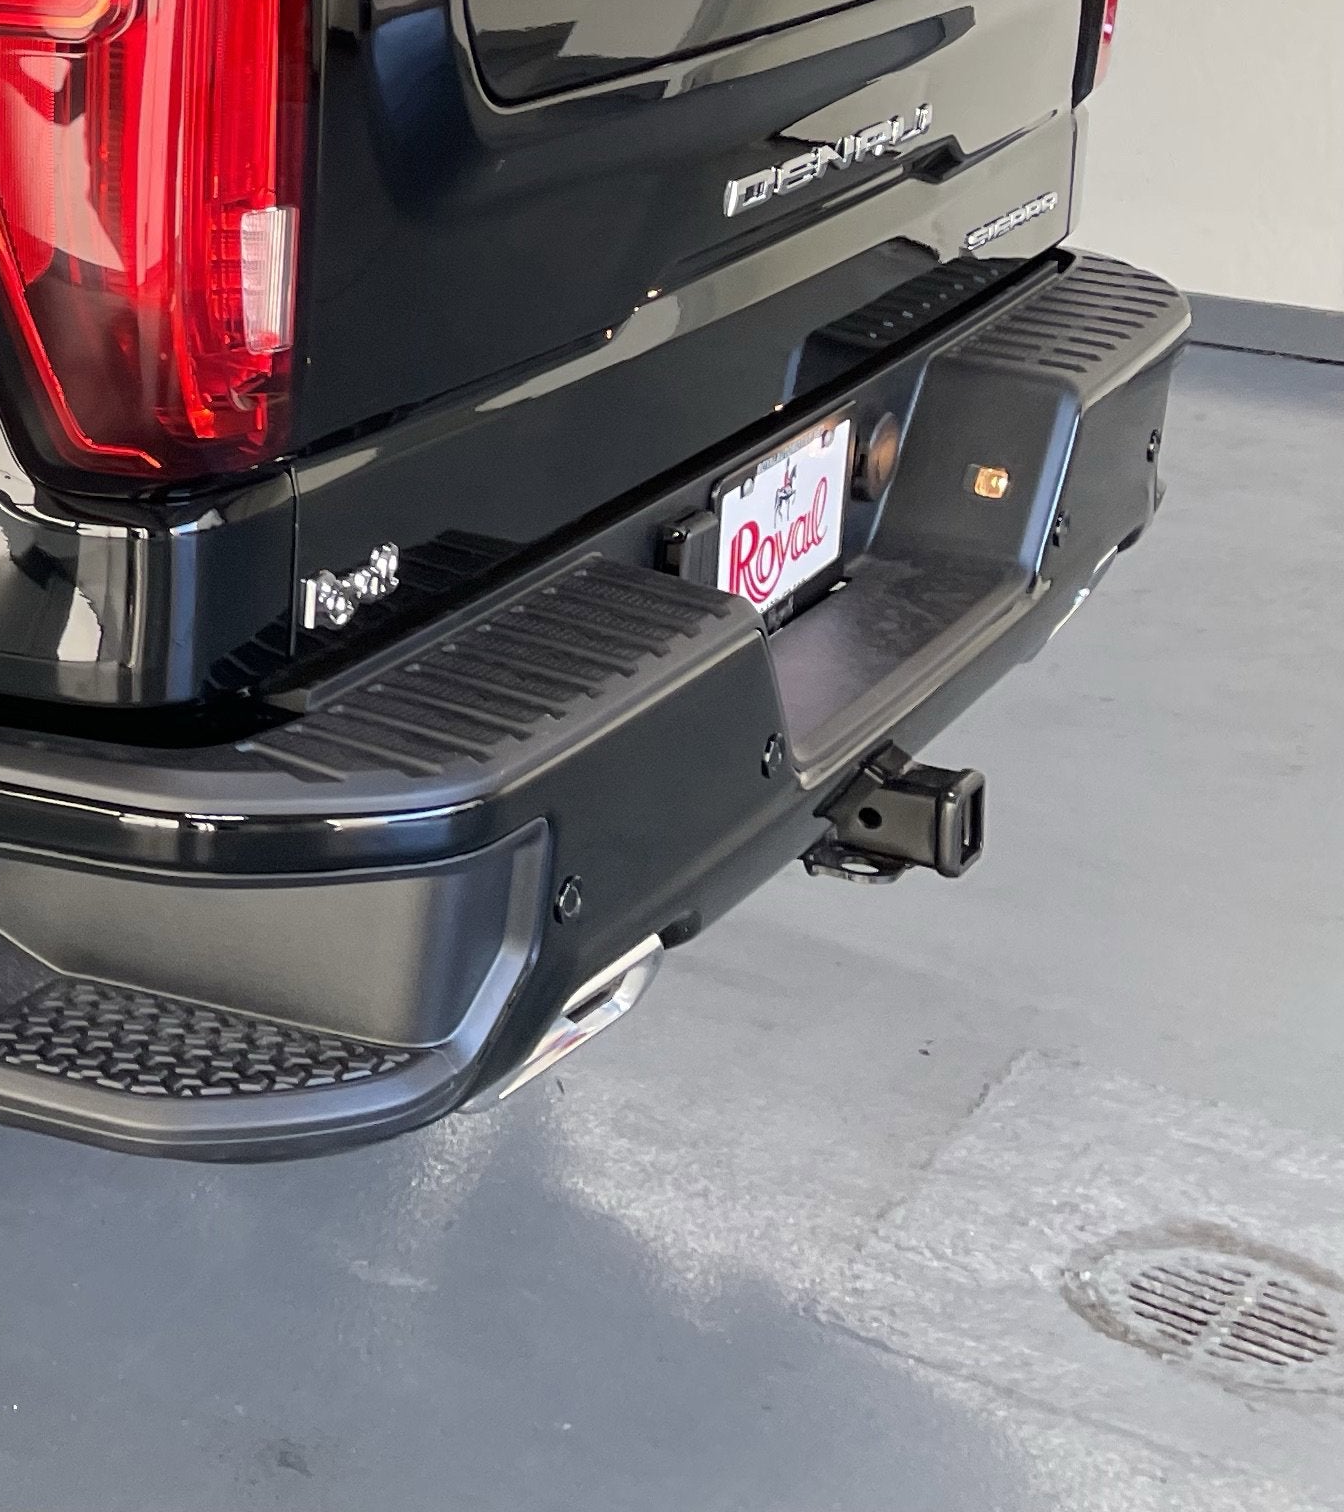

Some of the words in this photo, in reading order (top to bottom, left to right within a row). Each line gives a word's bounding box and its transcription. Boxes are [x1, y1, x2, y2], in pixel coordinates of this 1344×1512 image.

[722, 101, 933, 219] DENALI
[965, 190, 1059, 252] SIERRA
[728, 476, 829, 605] Royal
